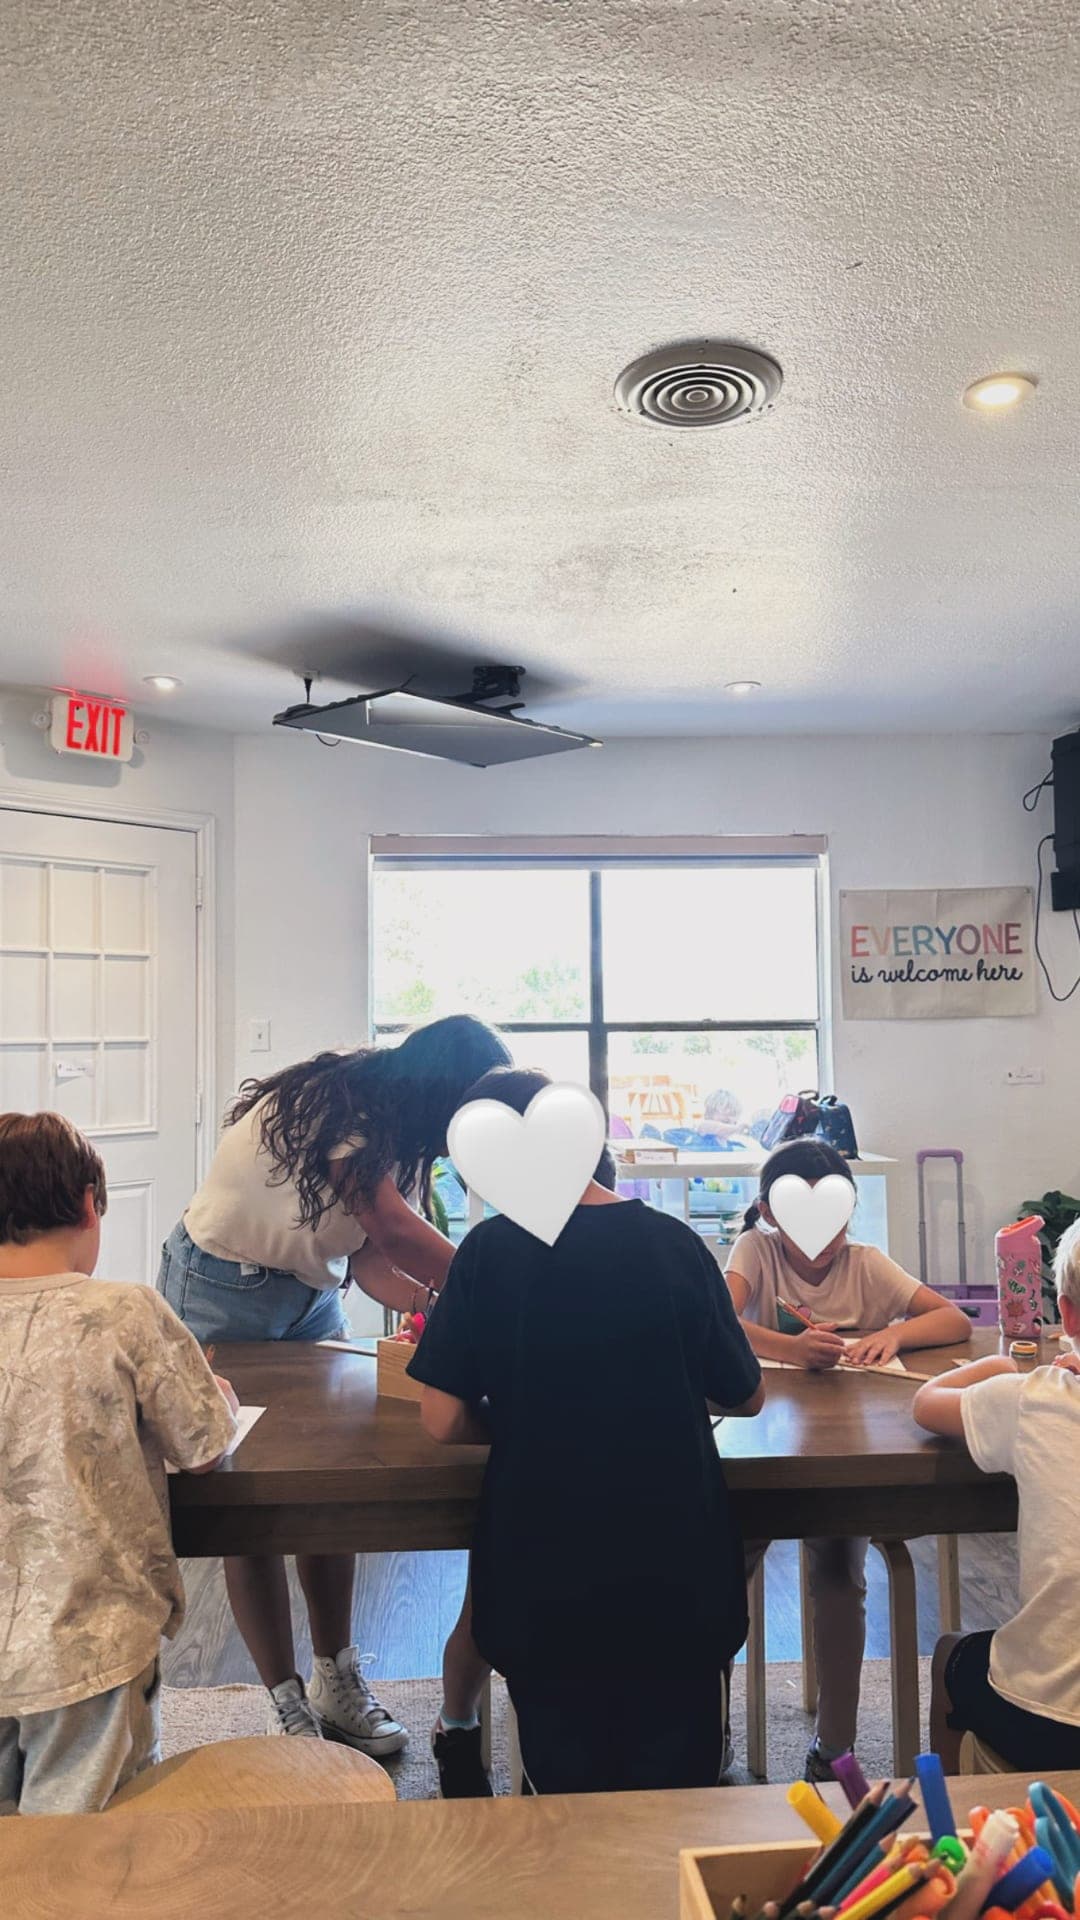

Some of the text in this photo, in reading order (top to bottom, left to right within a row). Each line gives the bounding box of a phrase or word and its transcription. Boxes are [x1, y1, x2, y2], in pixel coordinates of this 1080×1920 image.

[66, 699, 126, 756] EXIT
[851, 923, 1023, 957] EVERYONE
[851, 958, 1023, 983] is welcome here
